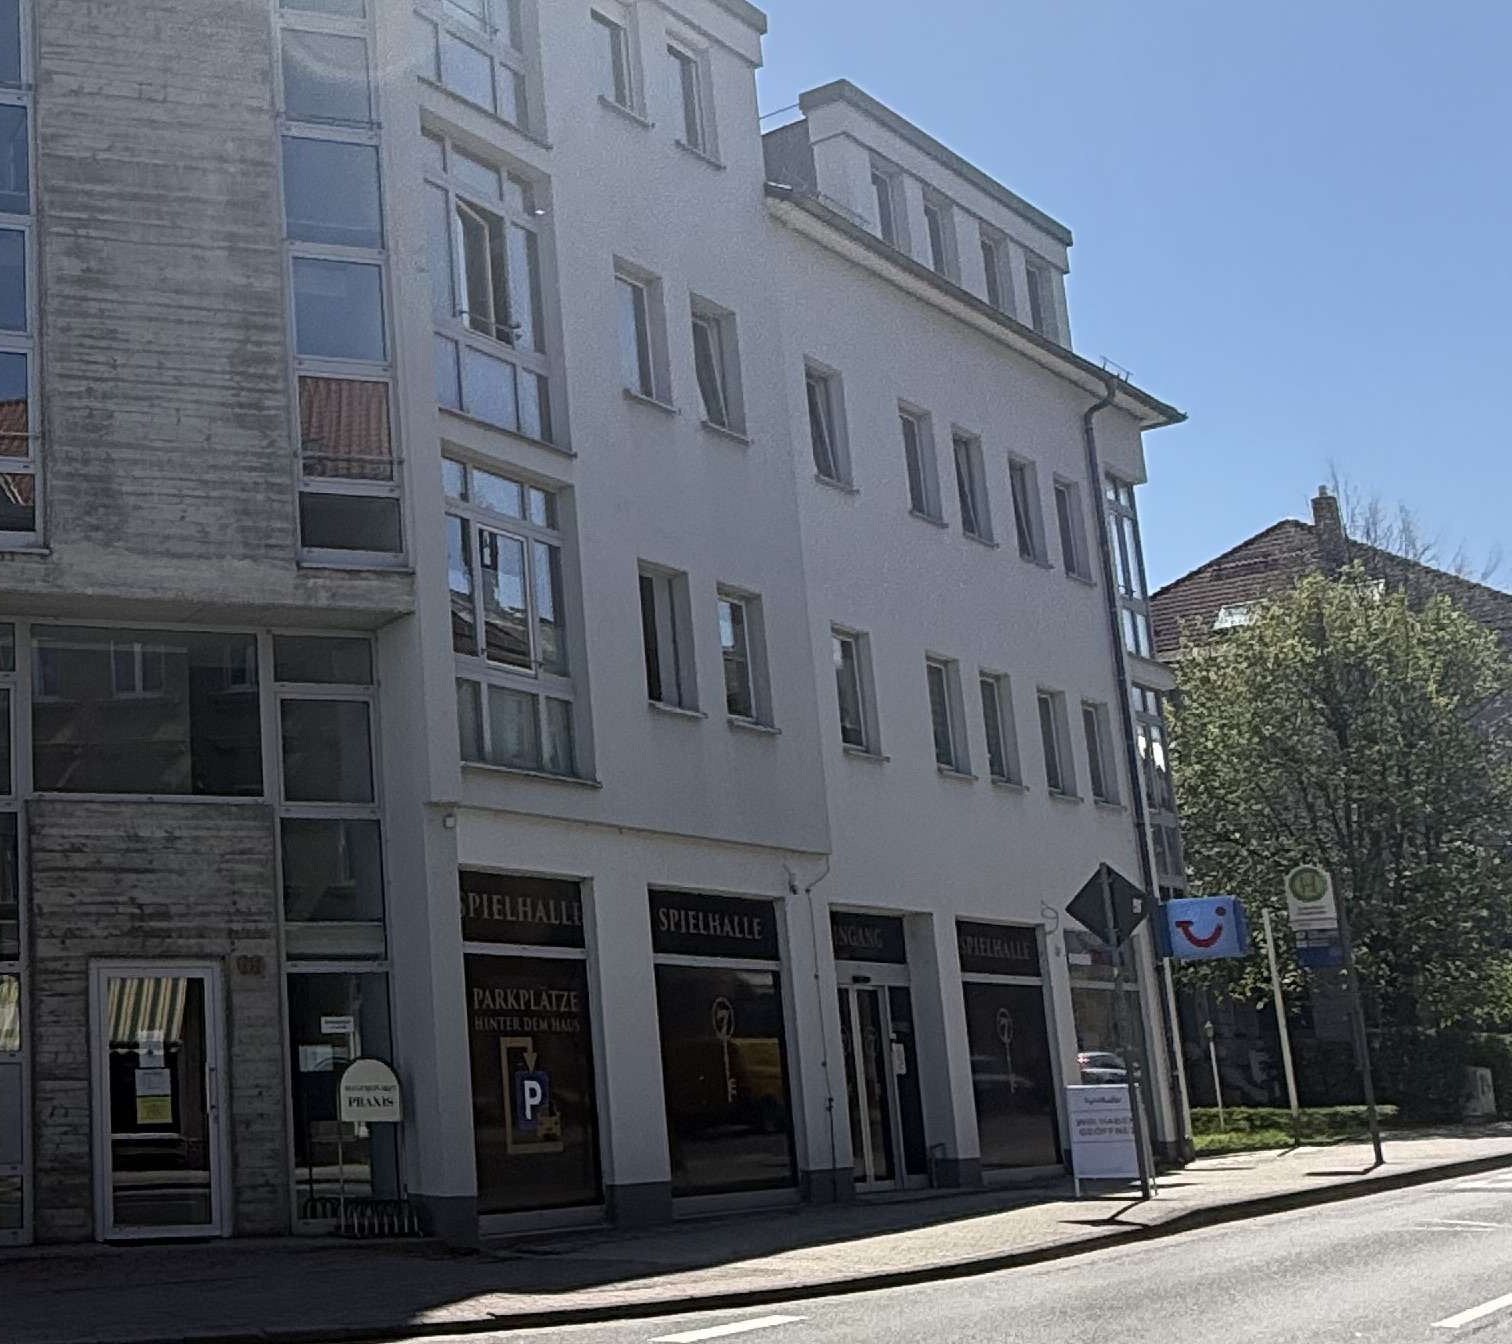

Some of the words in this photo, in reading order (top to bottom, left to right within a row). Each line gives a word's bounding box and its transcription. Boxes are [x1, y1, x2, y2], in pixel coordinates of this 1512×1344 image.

[658, 906, 762, 941] SPIELHALLE
[960, 935, 1032, 960] SPIELHALLE
[472, 984, 579, 1012] PARKPLÄTZE
[474, 1015, 521, 1032] HINTER
[524, 1016, 548, 1032] DEM
[551, 1017, 580, 1033] HAUS
[348, 1096, 394, 1108] PRAXIS
[523, 1080, 543, 1120] P
